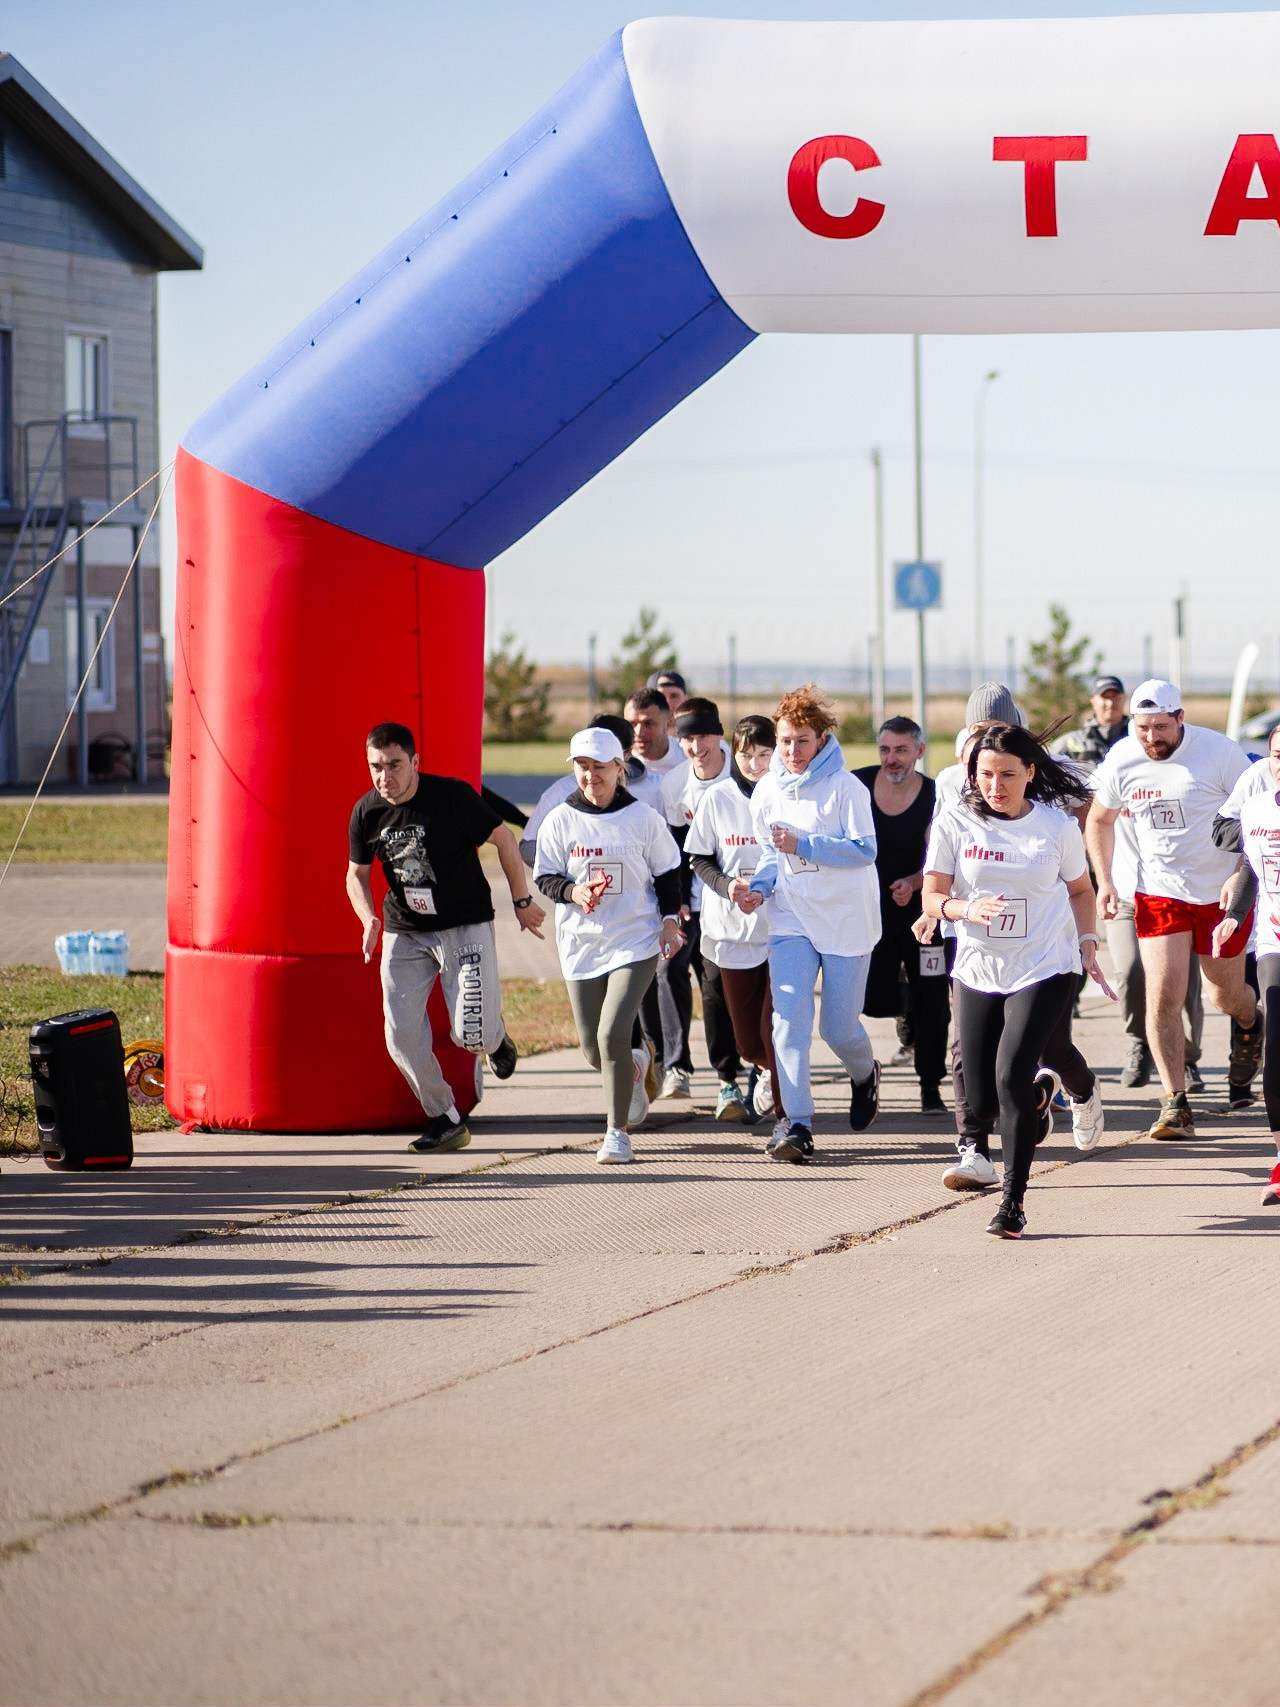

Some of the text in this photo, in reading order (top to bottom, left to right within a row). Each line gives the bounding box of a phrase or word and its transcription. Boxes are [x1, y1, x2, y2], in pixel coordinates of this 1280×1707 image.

[1159, 810, 1176, 825] 72
[724, 834, 758, 846] ultra
[570, 846, 603, 858] ultra
[964, 845, 1005, 862] ultra
[412, 897, 428, 911] 58
[998, 914, 1017, 931] 77
[453, 944, 484, 959] SENIOR
[926, 957, 940, 971] 47
